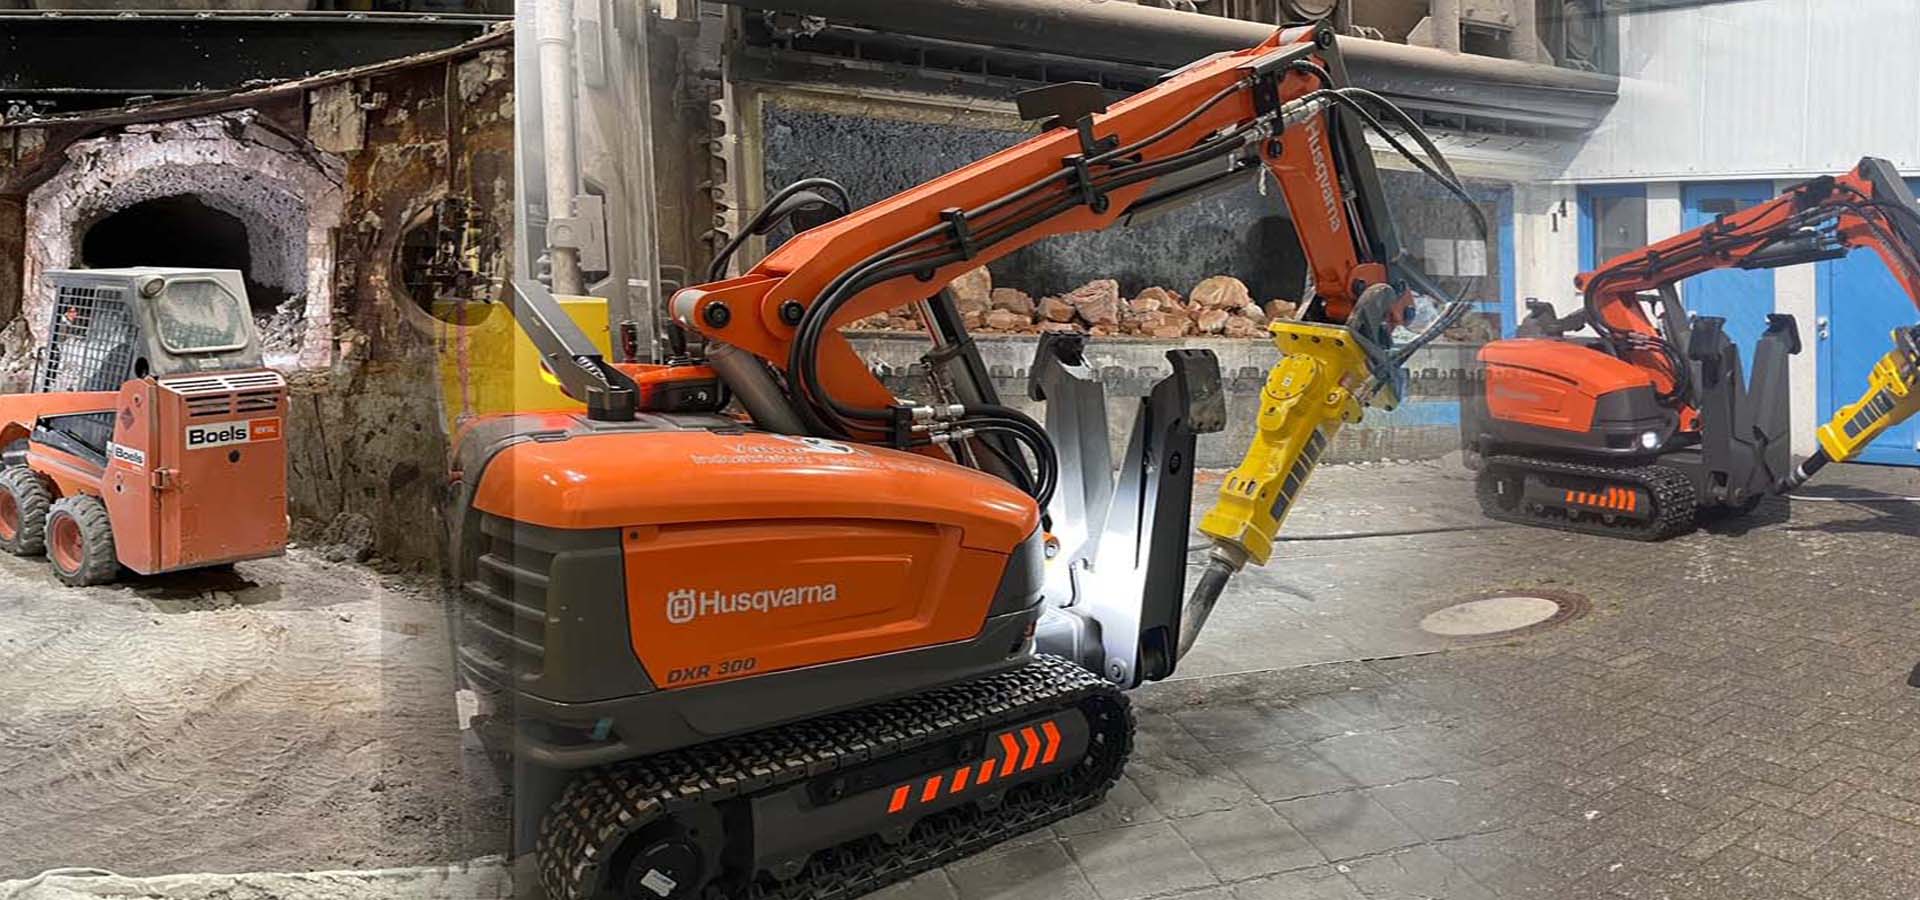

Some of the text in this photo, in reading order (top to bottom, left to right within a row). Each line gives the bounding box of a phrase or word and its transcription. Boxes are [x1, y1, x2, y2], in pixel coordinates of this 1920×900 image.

[1304, 120, 1340, 233] Husqvarna
[189, 425, 247, 445] Boels
[115, 446, 143, 464] Boels
[699, 583, 837, 616] Husqvarna
[666, 656, 757, 684] DXR 300
